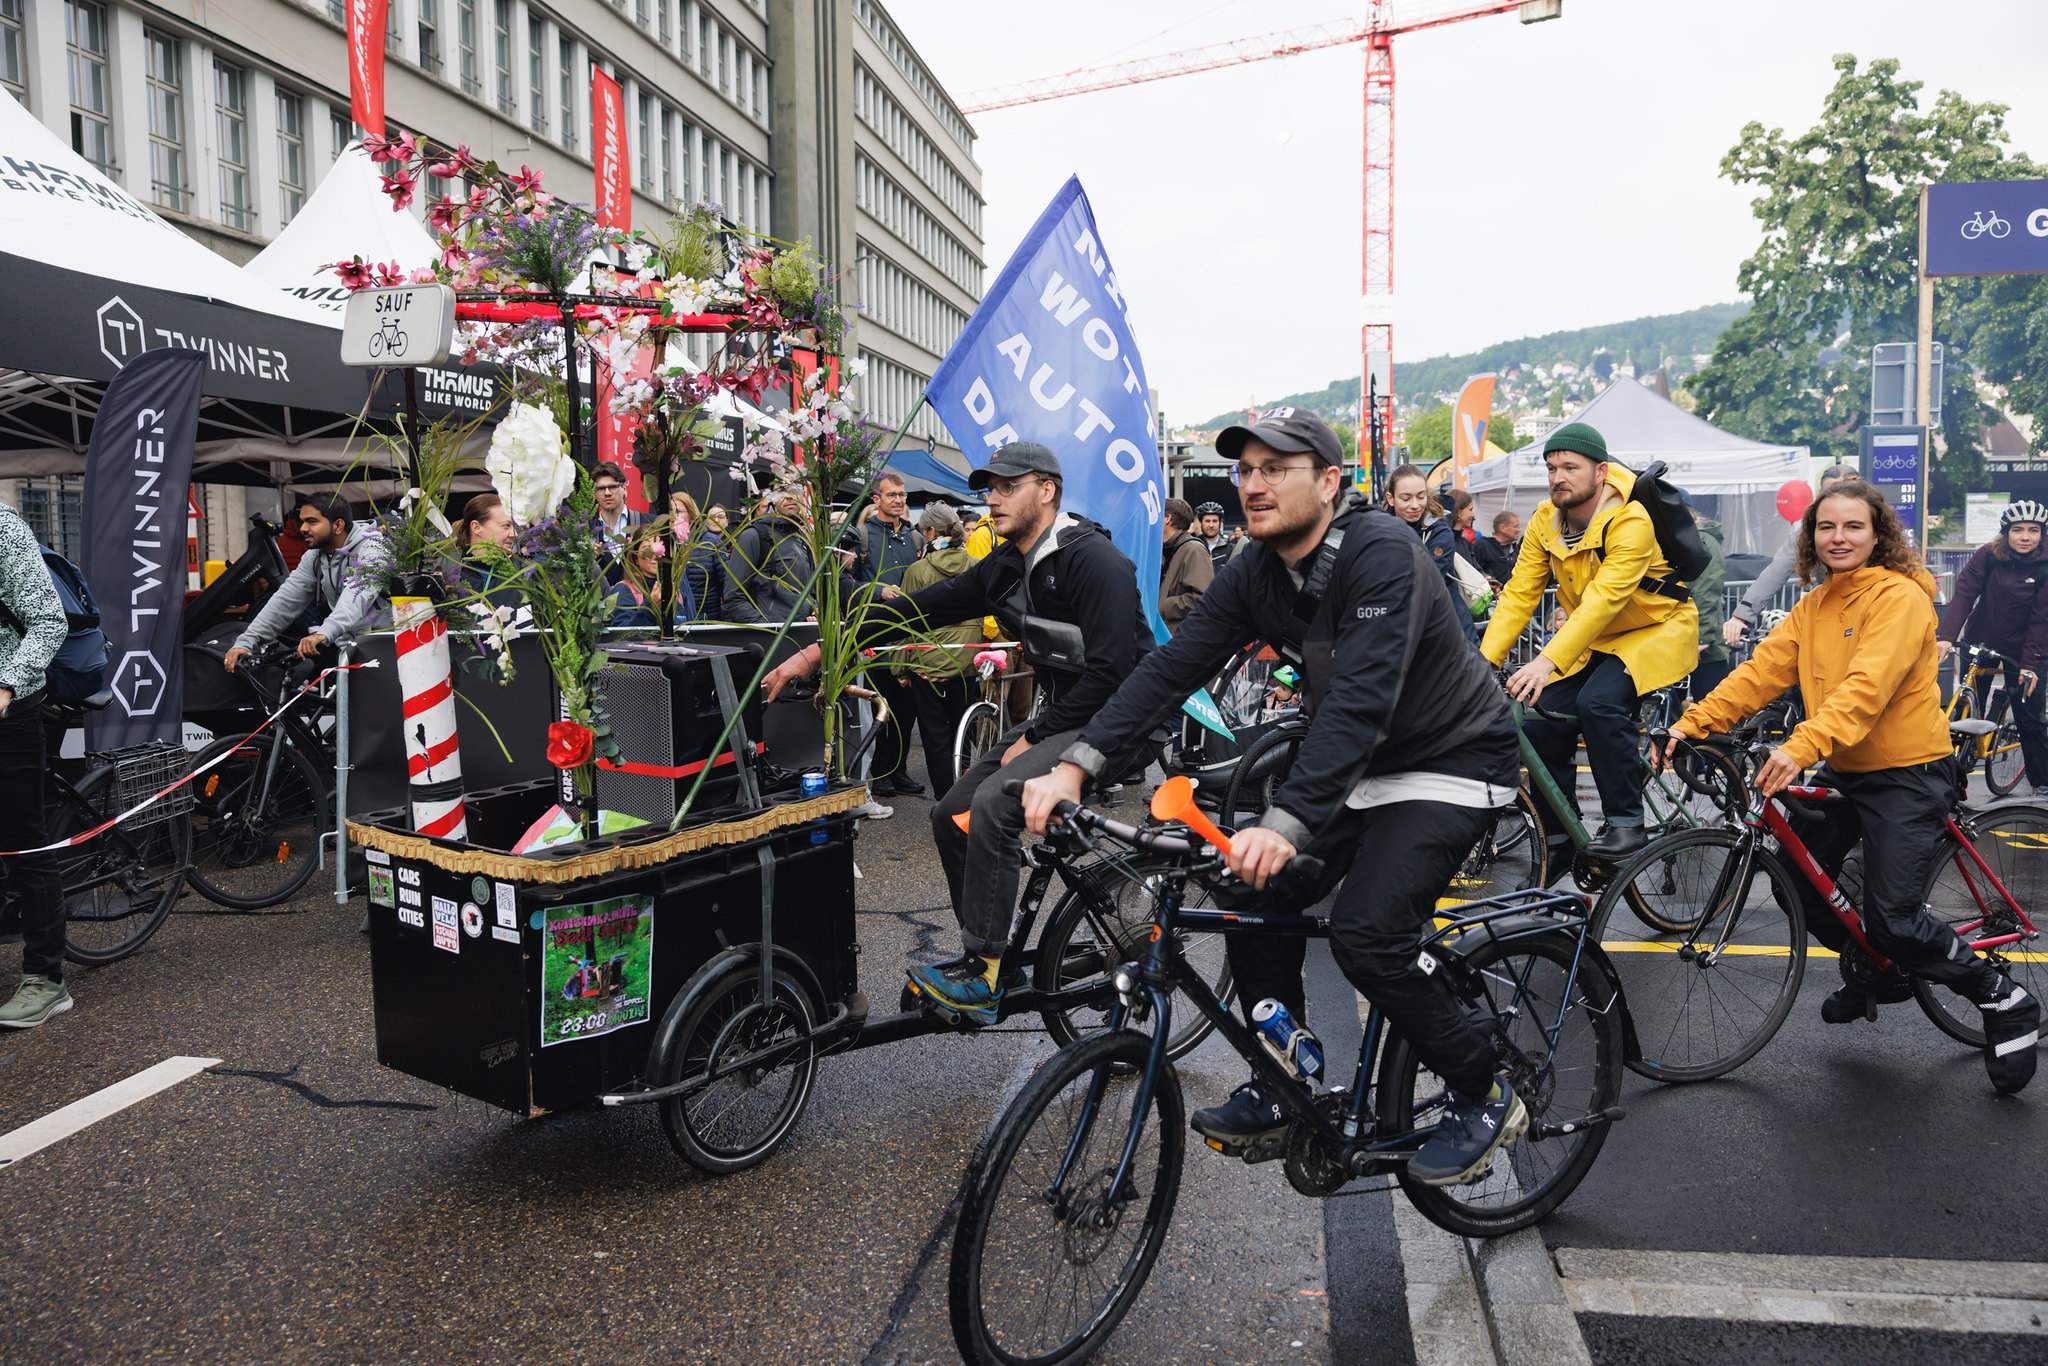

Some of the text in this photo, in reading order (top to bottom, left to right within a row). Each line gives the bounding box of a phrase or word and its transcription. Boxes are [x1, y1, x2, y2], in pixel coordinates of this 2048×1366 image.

[3, 178, 84, 202] BIKE
[375, 292, 413, 313] SAUF
[1040, 271, 1157, 438] WOTT
[424, 390, 493, 412] BIKE WORLD
[997, 332, 1161, 526] AUTOS
[131, 407, 166, 633] TWINNER
[398, 867, 421, 887] CARS
[399, 887, 422, 907] RUIN
[433, 899, 456, 916] HALLO
[398, 907, 425, 928] CITIES
[434, 911, 456, 927] VELO
[560, 1012, 607, 1034] 23:00
